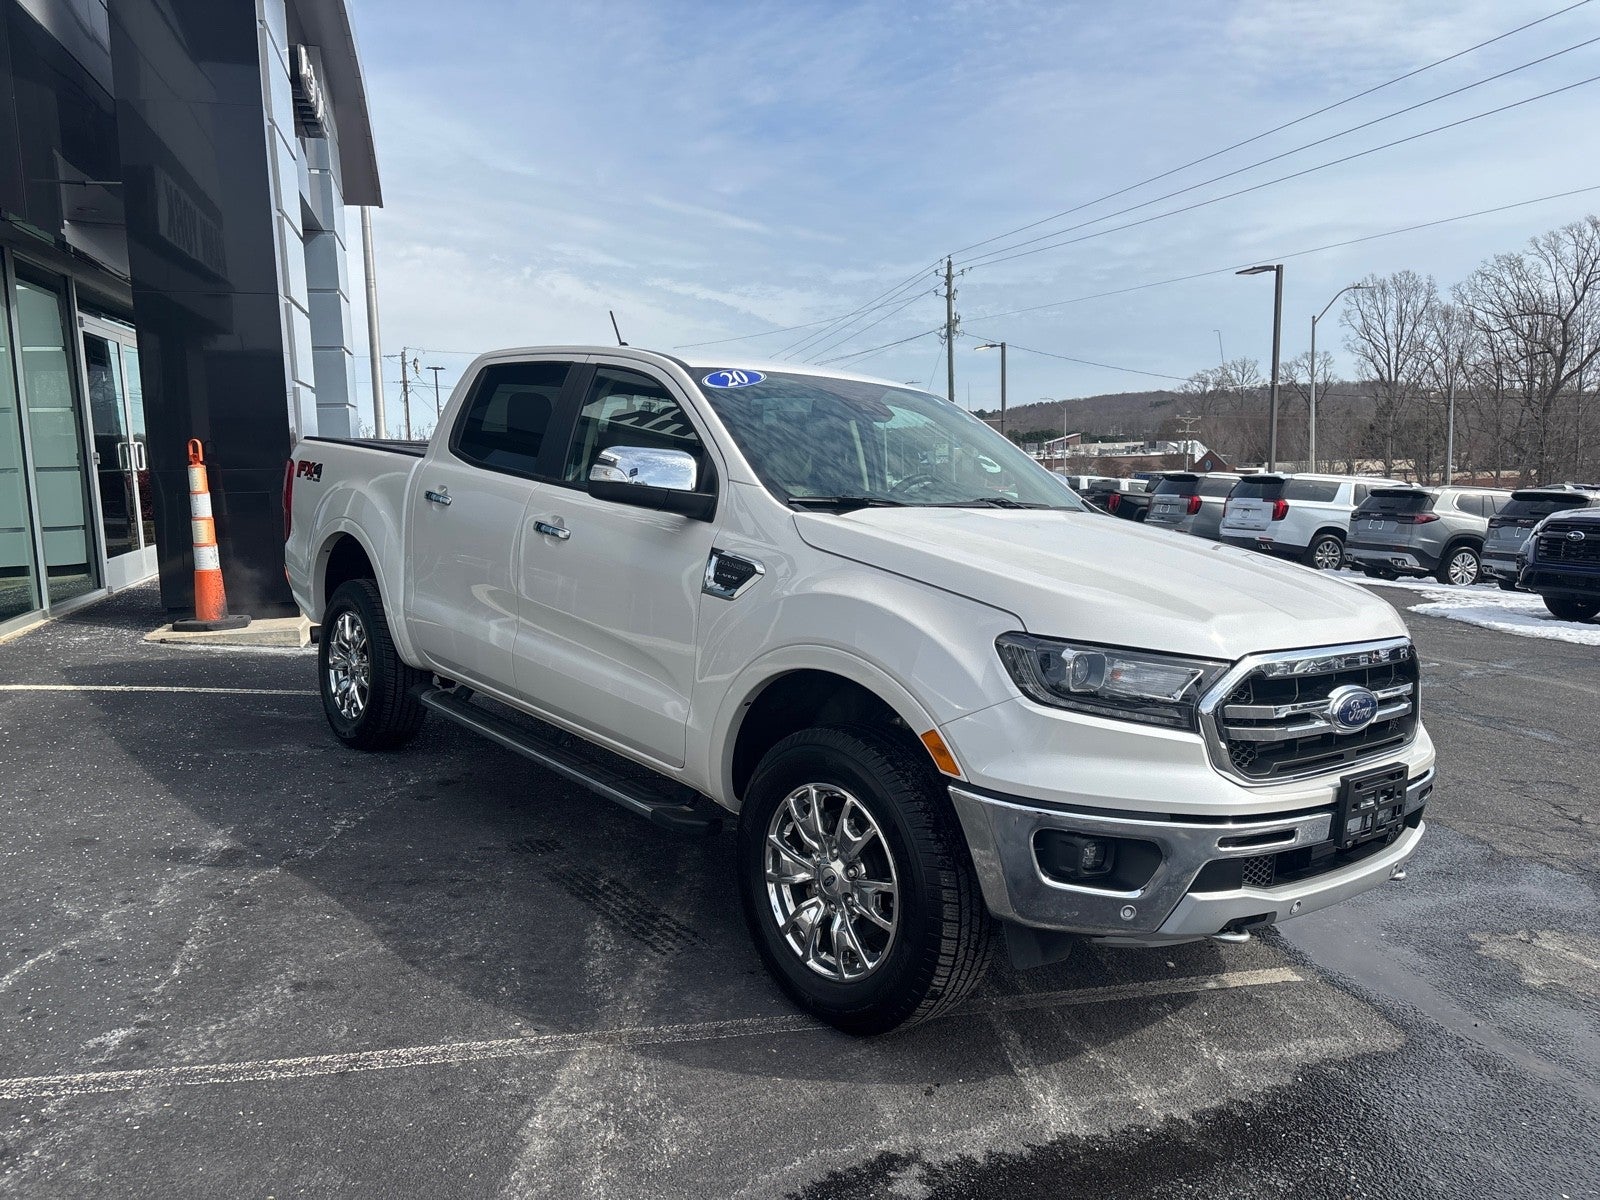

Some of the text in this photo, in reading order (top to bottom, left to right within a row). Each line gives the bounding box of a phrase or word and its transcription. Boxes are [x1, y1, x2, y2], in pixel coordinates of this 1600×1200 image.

[719, 370, 749, 387] 20
[297, 460, 323, 478] FX4
[1348, 699, 1373, 722] Ford
